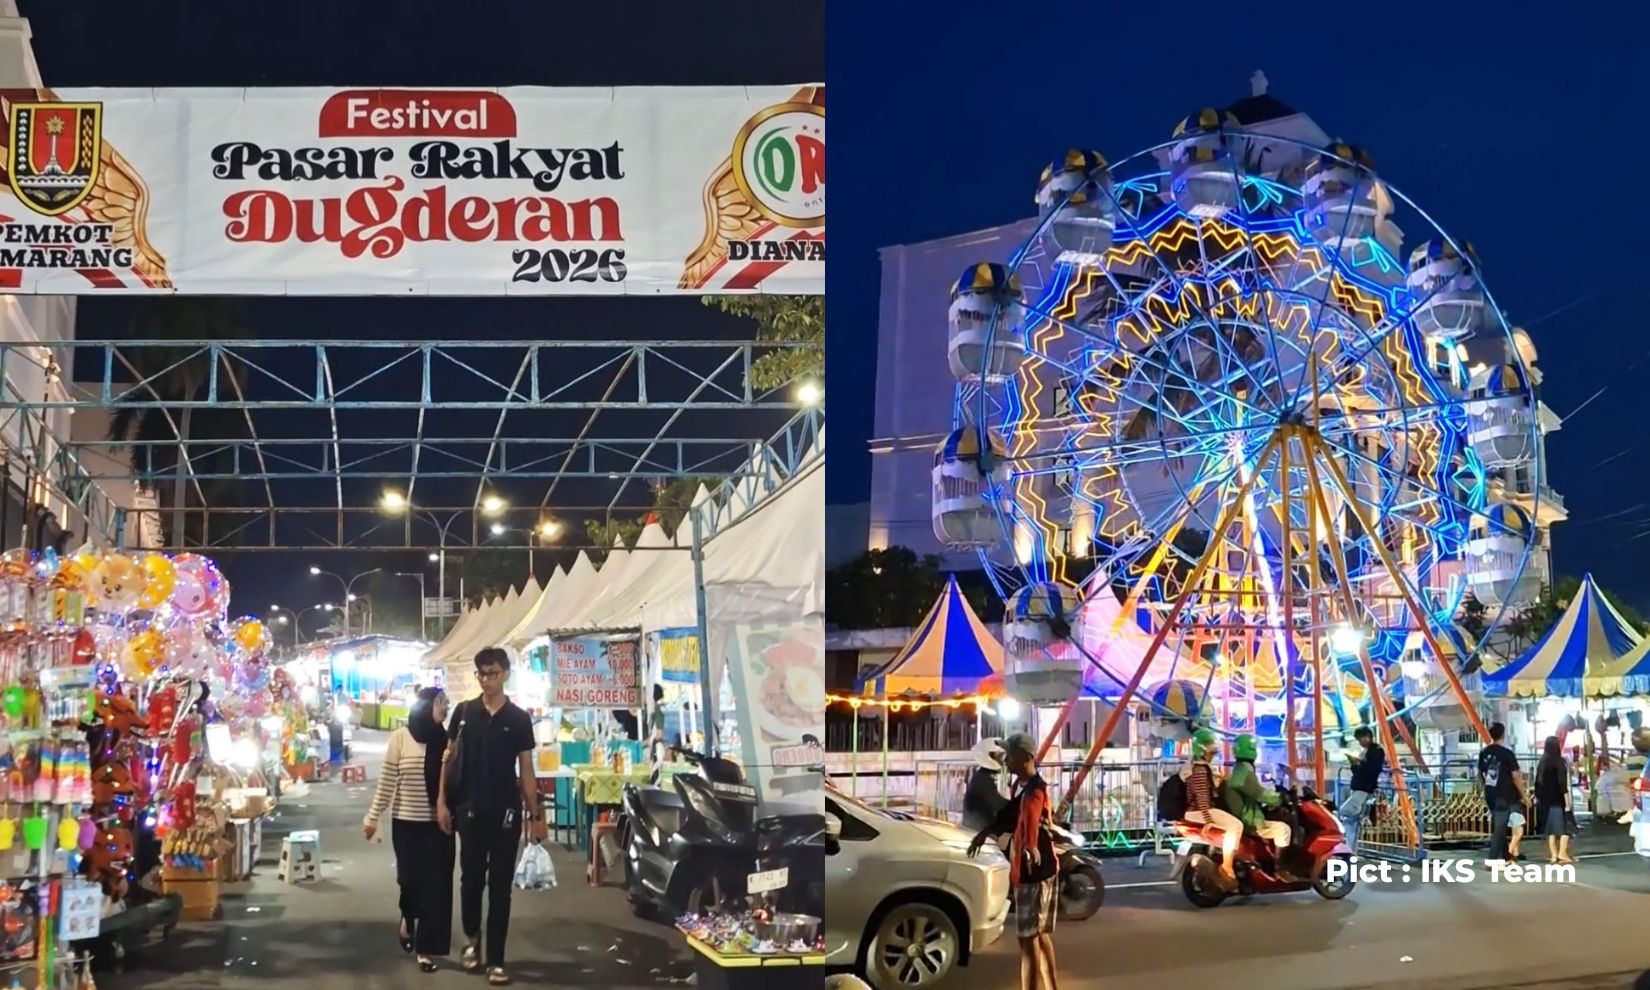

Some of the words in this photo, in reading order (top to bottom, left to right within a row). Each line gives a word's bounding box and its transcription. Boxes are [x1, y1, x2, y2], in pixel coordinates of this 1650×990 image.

[347, 97, 487, 130] Festival
[211, 141, 394, 181] Pasar
[408, 139, 625, 192] Rakyat
[222, 175, 624, 259] Dugderan
[0, 224, 113, 244] EMKOT
[727, 240, 825, 261] DIANA
[512, 248, 628, 283] 2026
[556, 640, 585, 655] BAKSO
[556, 658, 571, 669] MIE
[574, 658, 596, 670] AYAM
[556, 673, 578, 684] SOTO
[556, 689, 584, 702] NASI
[587, 689, 636, 703] GORENG
